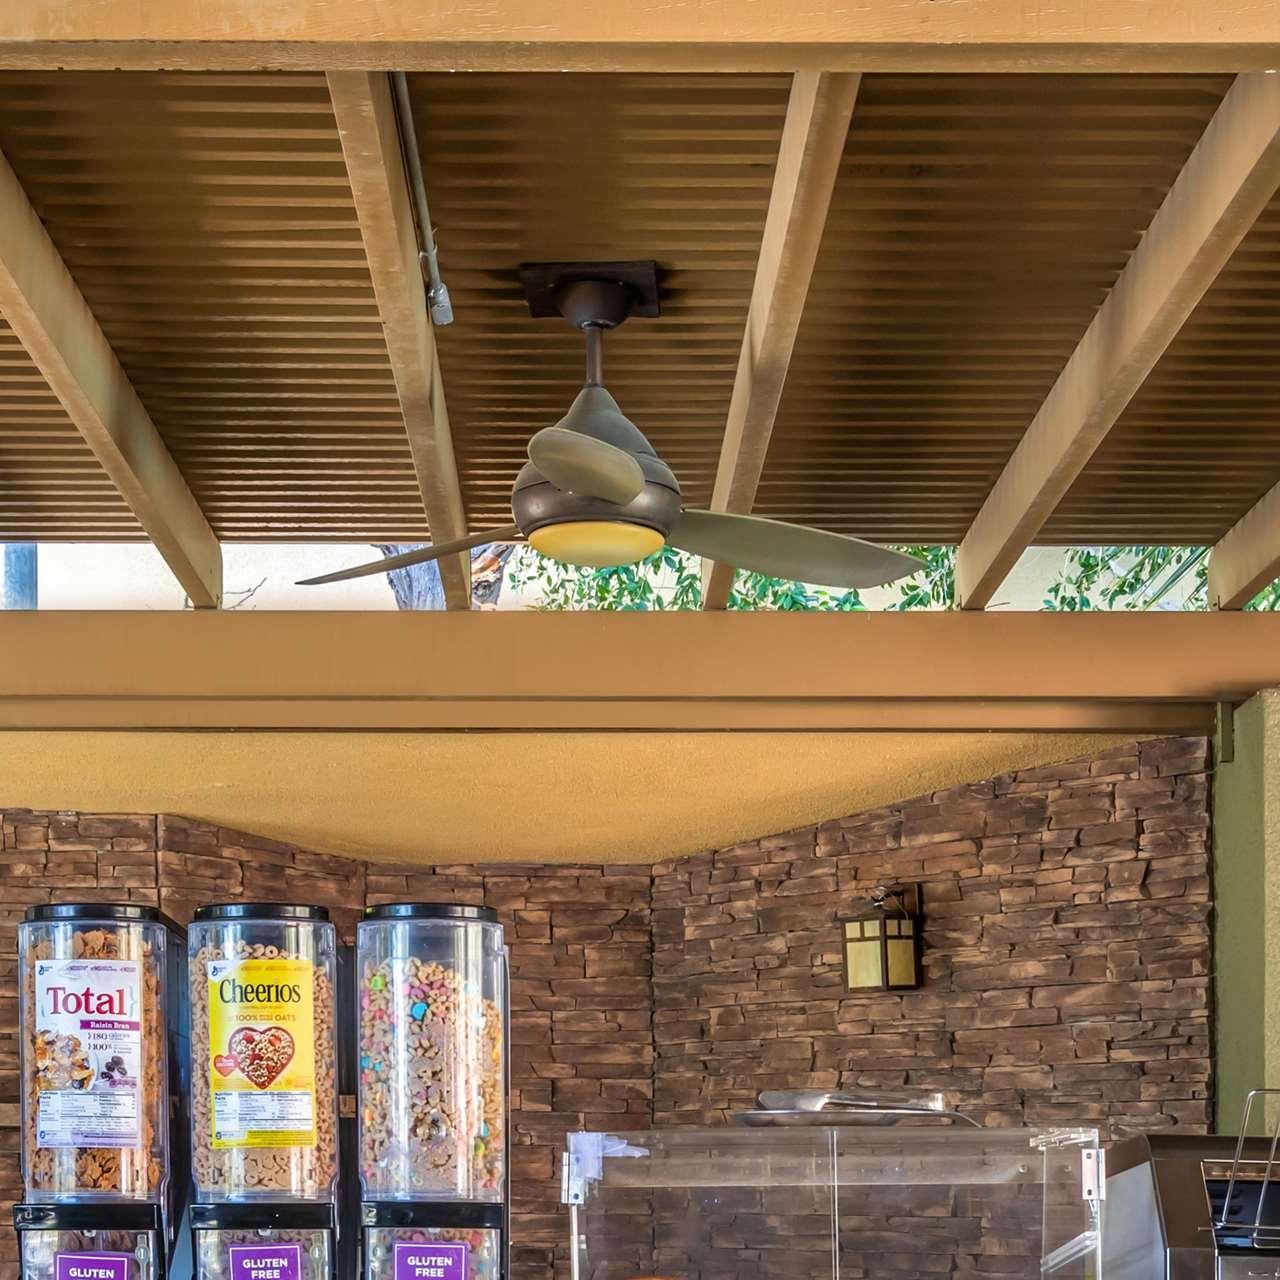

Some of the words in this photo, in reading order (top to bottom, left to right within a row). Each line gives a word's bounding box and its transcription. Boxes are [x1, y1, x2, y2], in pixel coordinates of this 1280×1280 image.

[219, 978, 301, 1003] Cheerios
[46, 986, 127, 1015] Total
[91, 1021, 113, 1029] Raisin
[242, 1257, 288, 1269] GLUTEN
[407, 1256, 453, 1266] GLUTEN
[68, 1267, 115, 1279] GLUTEN
[251, 1269, 281, 1279] FREE
[415, 1267, 445, 1277] FREE
